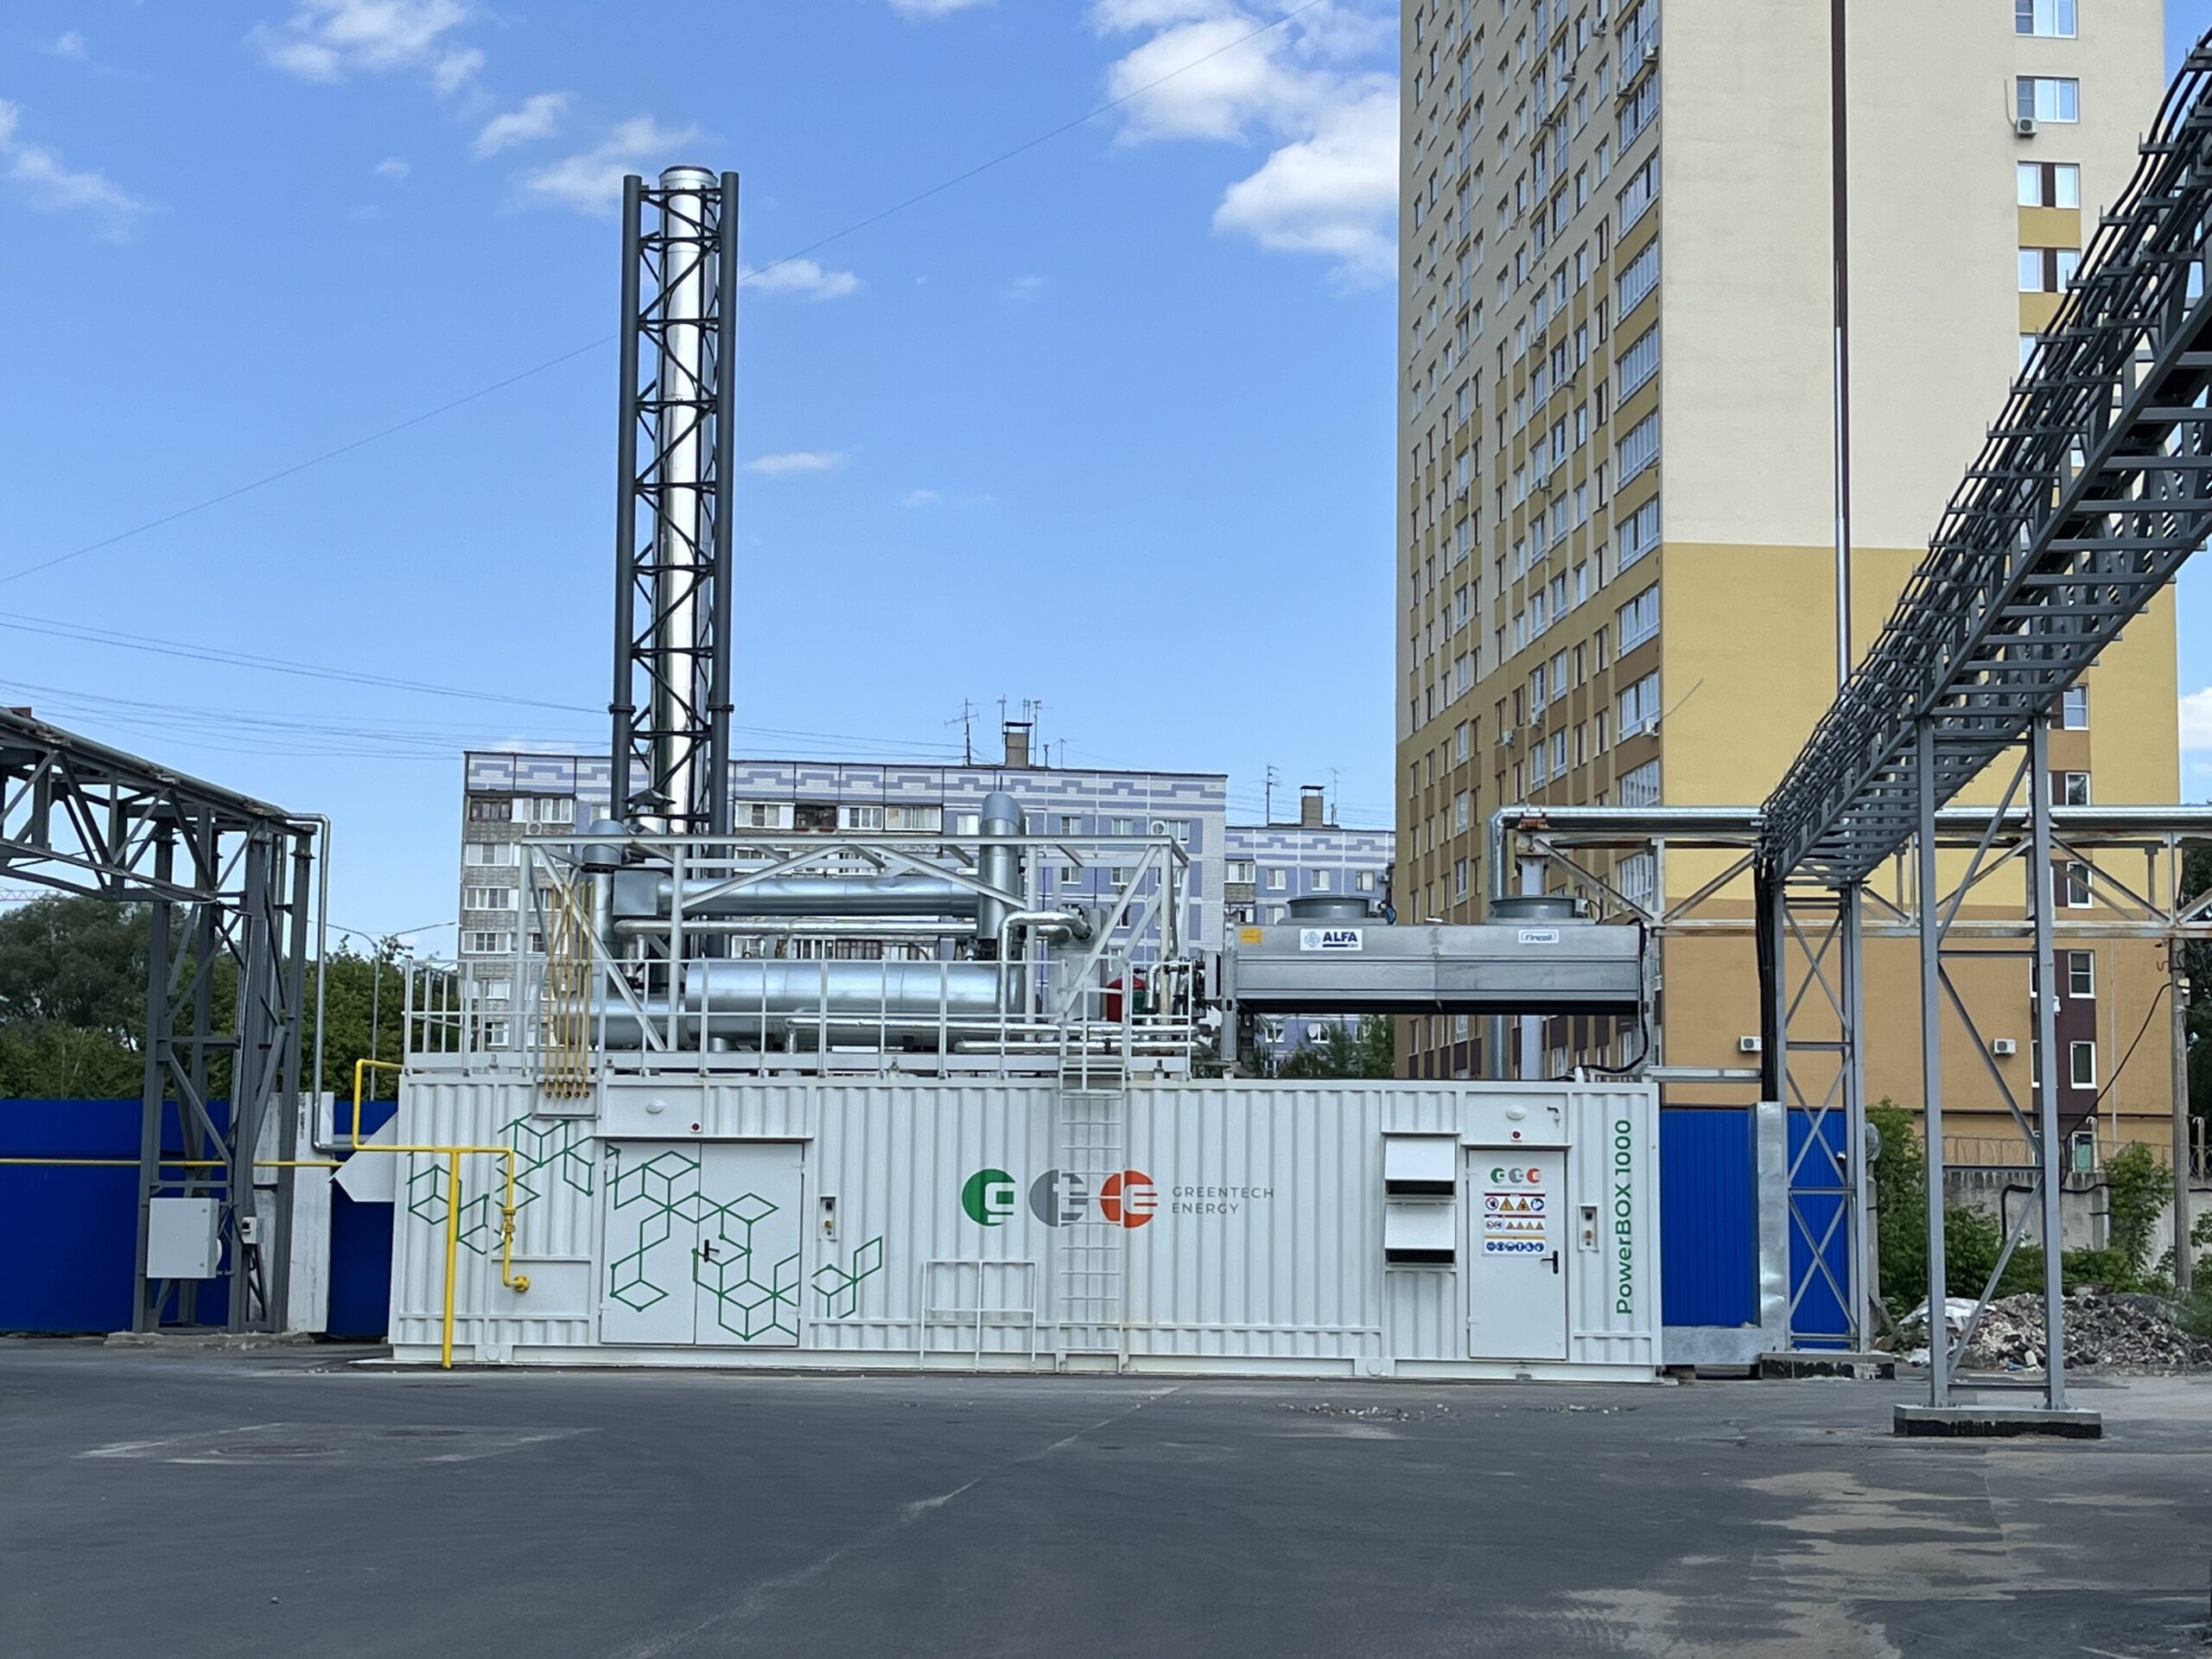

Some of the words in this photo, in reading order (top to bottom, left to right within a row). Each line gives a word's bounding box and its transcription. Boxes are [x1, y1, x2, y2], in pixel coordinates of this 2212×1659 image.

[1322, 931, 1358, 943] ALFA
[1614, 1119, 1631, 1176] 1000
[1172, 1185, 1274, 1199] GREENTECH
[1172, 1202, 1239, 1214] ENERGY
[1614, 1183, 1632, 1314] PowerBOX
